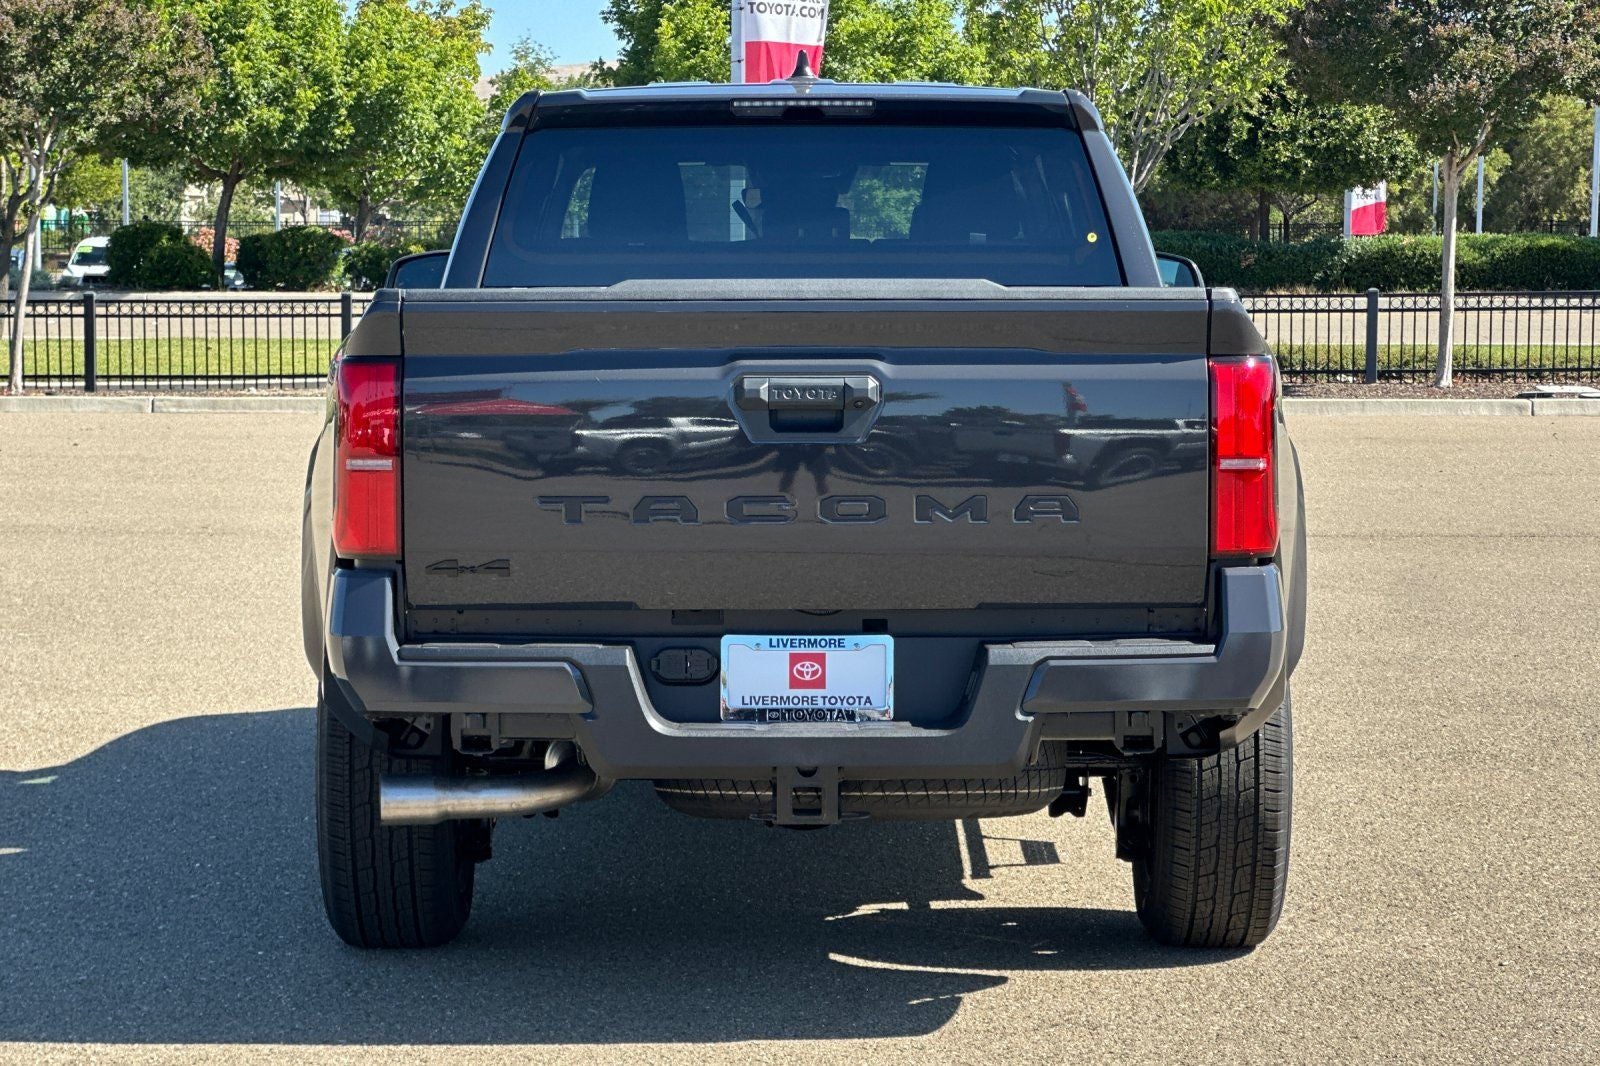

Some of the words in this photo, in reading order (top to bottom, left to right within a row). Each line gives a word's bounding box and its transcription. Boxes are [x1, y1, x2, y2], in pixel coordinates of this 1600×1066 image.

[772, 387, 838, 400] TOYOTA
[537, 494, 1080, 525] TACOMA
[768, 637, 846, 649] LIVERMORE
[741, 695, 820, 706] LIVERMORE
[821, 695, 873, 706] TOYOTA
[784, 708, 848, 721] TOYOTA
